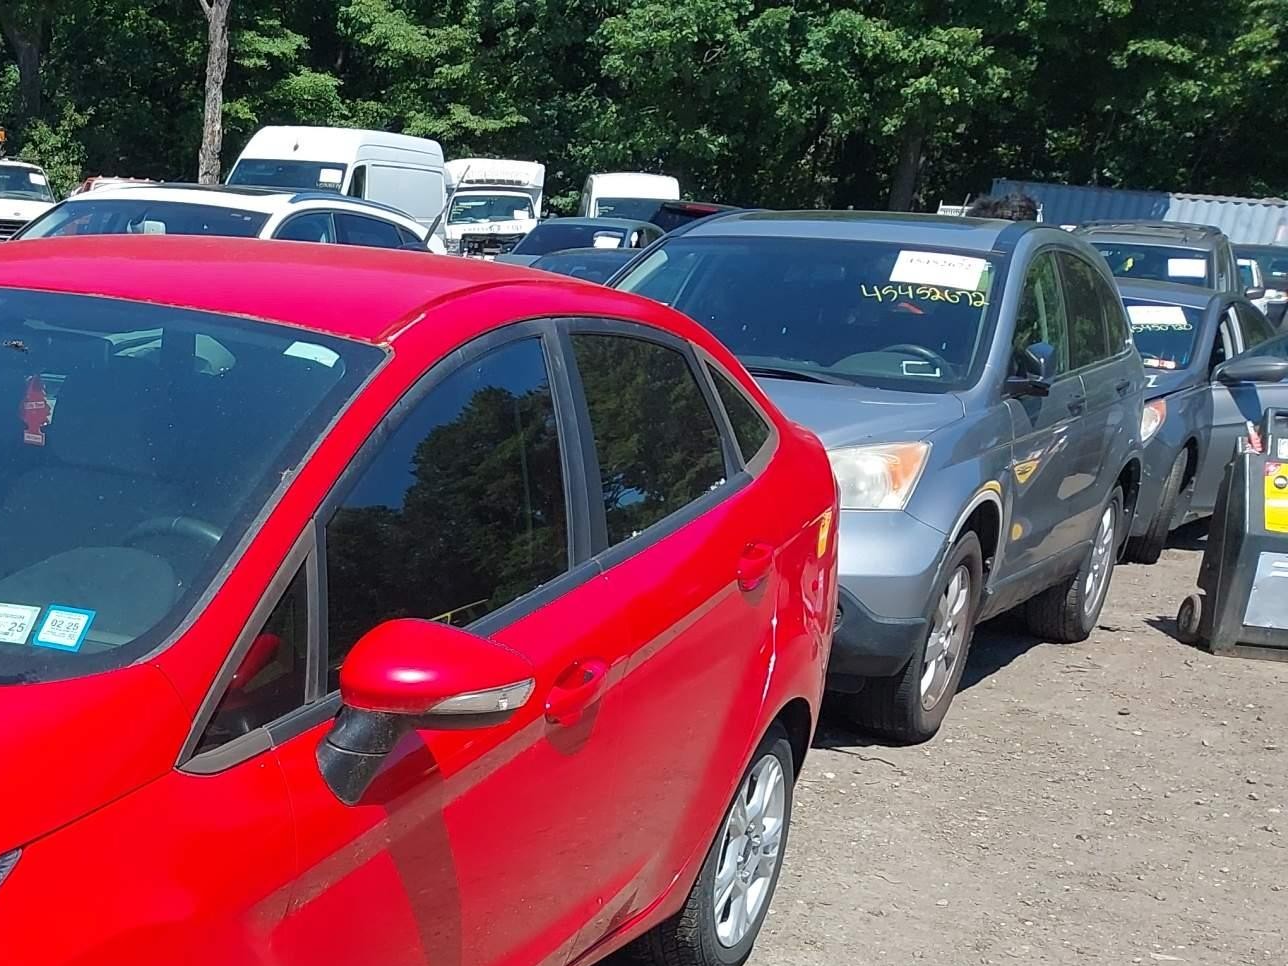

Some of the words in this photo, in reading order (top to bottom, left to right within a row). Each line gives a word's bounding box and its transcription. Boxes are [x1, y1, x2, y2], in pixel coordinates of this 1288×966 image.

[860, 284, 991, 307] 45452672
[7, 622, 27, 633] 25
[66, 621, 80, 632] 25
